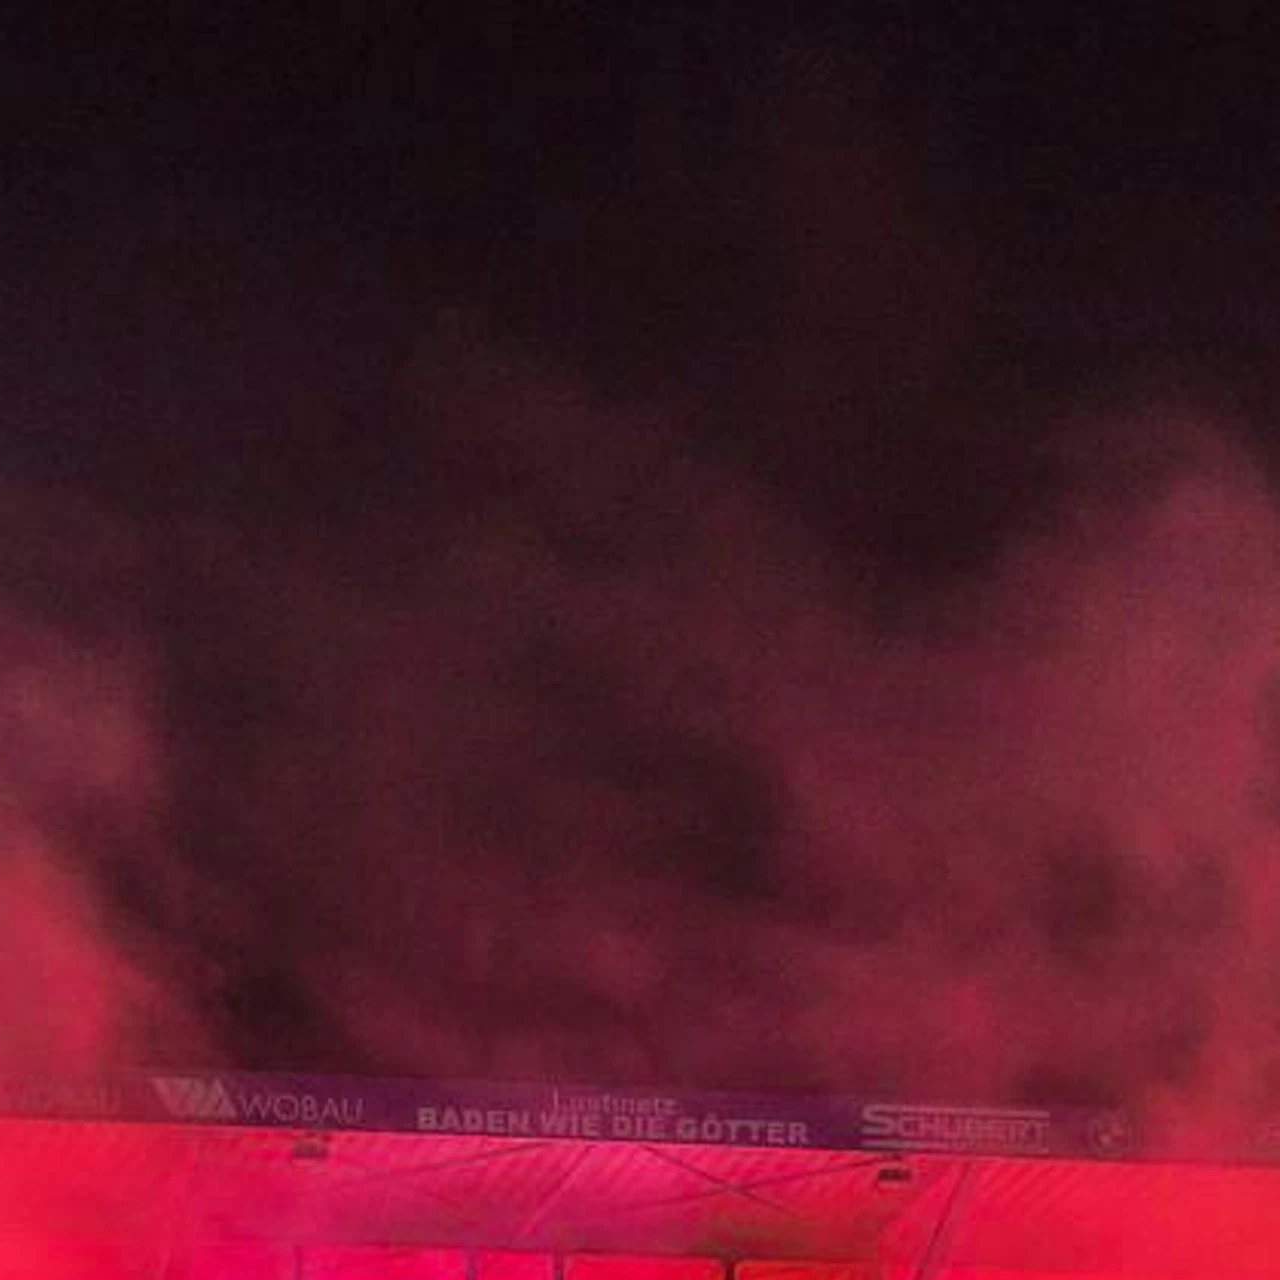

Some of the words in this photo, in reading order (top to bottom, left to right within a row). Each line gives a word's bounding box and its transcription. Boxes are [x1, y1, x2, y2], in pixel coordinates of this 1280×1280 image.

[239, 1094, 363, 1123] WOBAU
[419, 1106, 530, 1136] BADEN
[536, 1111, 599, 1139] WIE
[610, 1114, 668, 1141] DIE
[676, 1111, 810, 1146] GÖTTER
